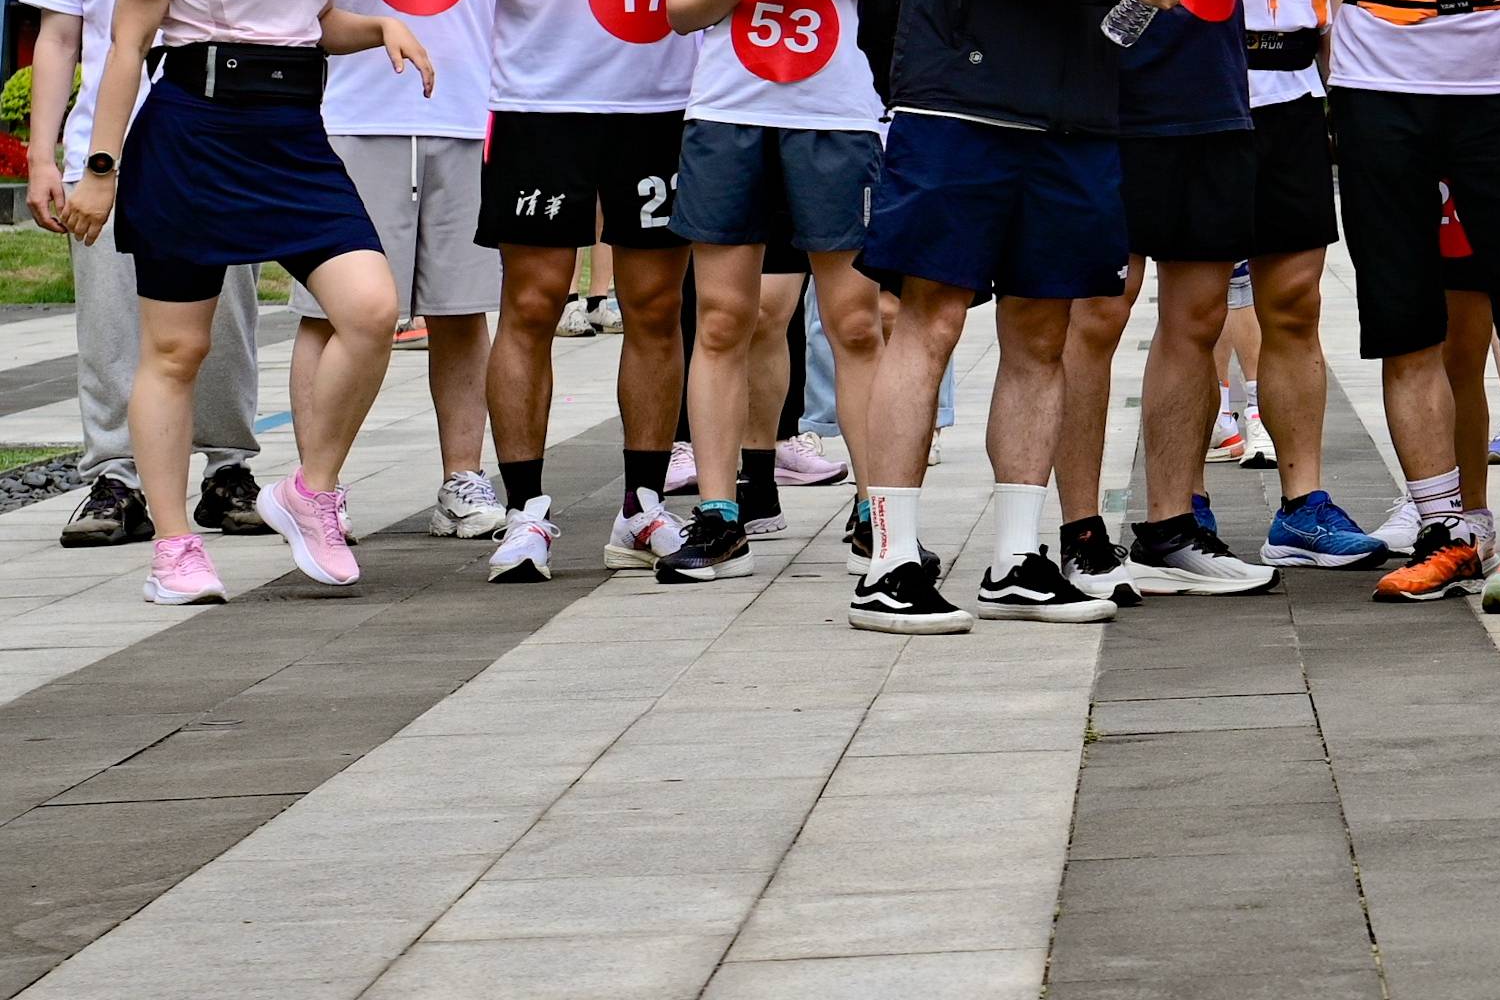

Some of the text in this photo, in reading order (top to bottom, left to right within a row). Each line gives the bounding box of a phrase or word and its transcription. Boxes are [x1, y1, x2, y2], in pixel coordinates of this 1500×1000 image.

[747, 2, 821, 53] 53
[1260, 41, 1284, 50] RUN
[637, 172, 678, 229] 2
